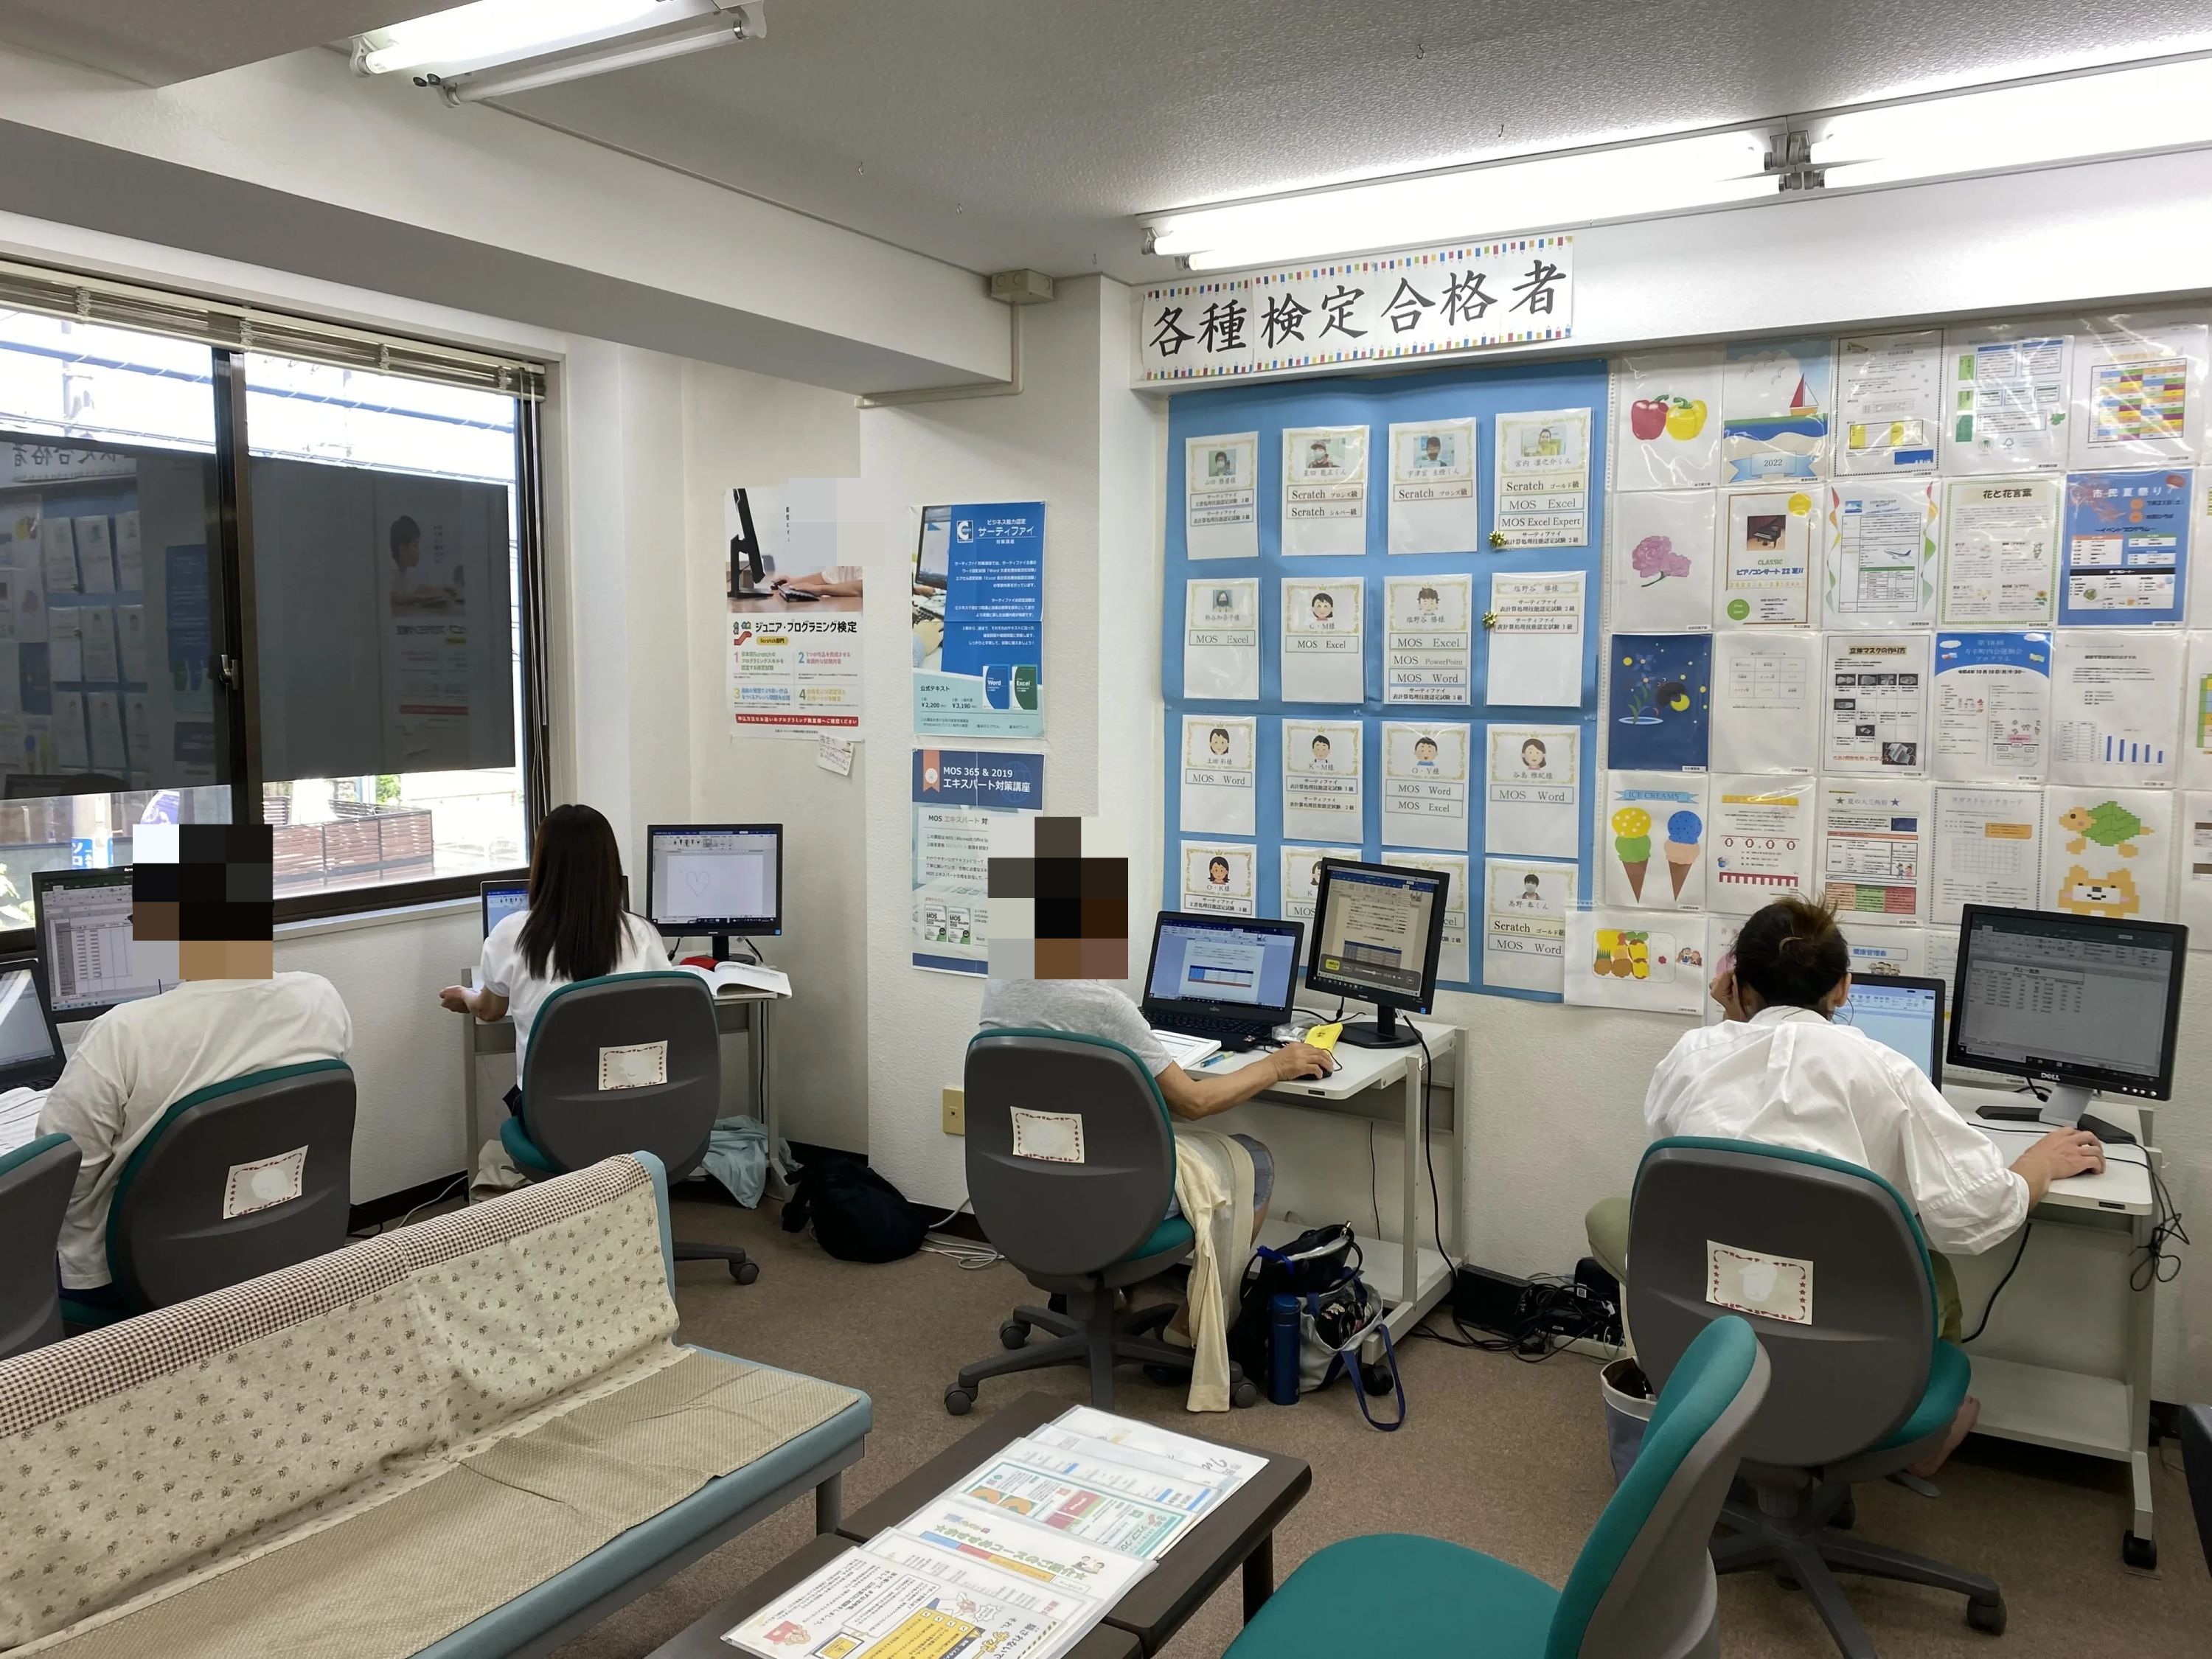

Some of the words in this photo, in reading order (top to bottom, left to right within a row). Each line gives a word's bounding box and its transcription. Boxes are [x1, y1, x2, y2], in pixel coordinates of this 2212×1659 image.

[1149, 260, 1567, 358] 各種検定合格者
[1764, 459, 1783, 467] 2022
[1506, 481, 1544, 492] Scratch
[1551, 481, 1579, 490] ゴールド級
[1292, 490, 1326, 499] Scratch
[1399, 490, 1434, 499] Scratch
[1983, 488, 2033, 499] 花と花言葉
[1509, 501, 1536, 509] MOS
[1548, 499, 1576, 509] Excel
[1291, 507, 1325, 516] Scratch
[1502, 518, 1525, 527] MOS
[1528, 518, 1551, 526] Excel
[1553, 518, 1581, 528] Expert
[978, 526, 1034, 537] サーティファイ
[755, 620, 858, 633] ジュニア・プログラミング検定
[1196, 635, 1218, 644] MOS
[1227, 636, 1249, 644] Excel
[1297, 641, 1318, 649] MOS
[1326, 641, 1346, 649] Excel
[1397, 639, 1422, 647] MOS
[1433, 639, 1460, 647] Excel
[1850, 647, 1906, 655] 立体マスクの作り方
[799, 652, 804, 664] 2
[1394, 656, 1419, 664] MOS
[1397, 674, 1422, 683] MOS
[1433, 674, 1458, 683] Word
[799, 689, 806, 700] 4
[944, 767, 961, 776] MOS
[964, 768, 979, 776] 365
[992, 769, 1012, 778] 2019
[1192, 773, 1214, 783] MOS
[1223, 775, 1245, 785] Word
[943, 779, 1031, 793] エキスパート対策講座
[1398, 785, 1420, 793] MOS
[1429, 787, 1451, 796] Word
[1499, 790, 1526, 799] MOS
[1538, 791, 1565, 801] Word
[1398, 801, 1420, 810] MOS
[1429, 803, 1450, 812] Excel
[945, 815, 979, 824] エキスパート
[1494, 921, 1530, 933] Scratch
[1497, 939, 1523, 950] MOS
[1534, 942, 1562, 954] Word
[2041, 1072, 2061, 1081] DELL
[945, 1528, 1076, 1577] おすすめコースのご紹介
